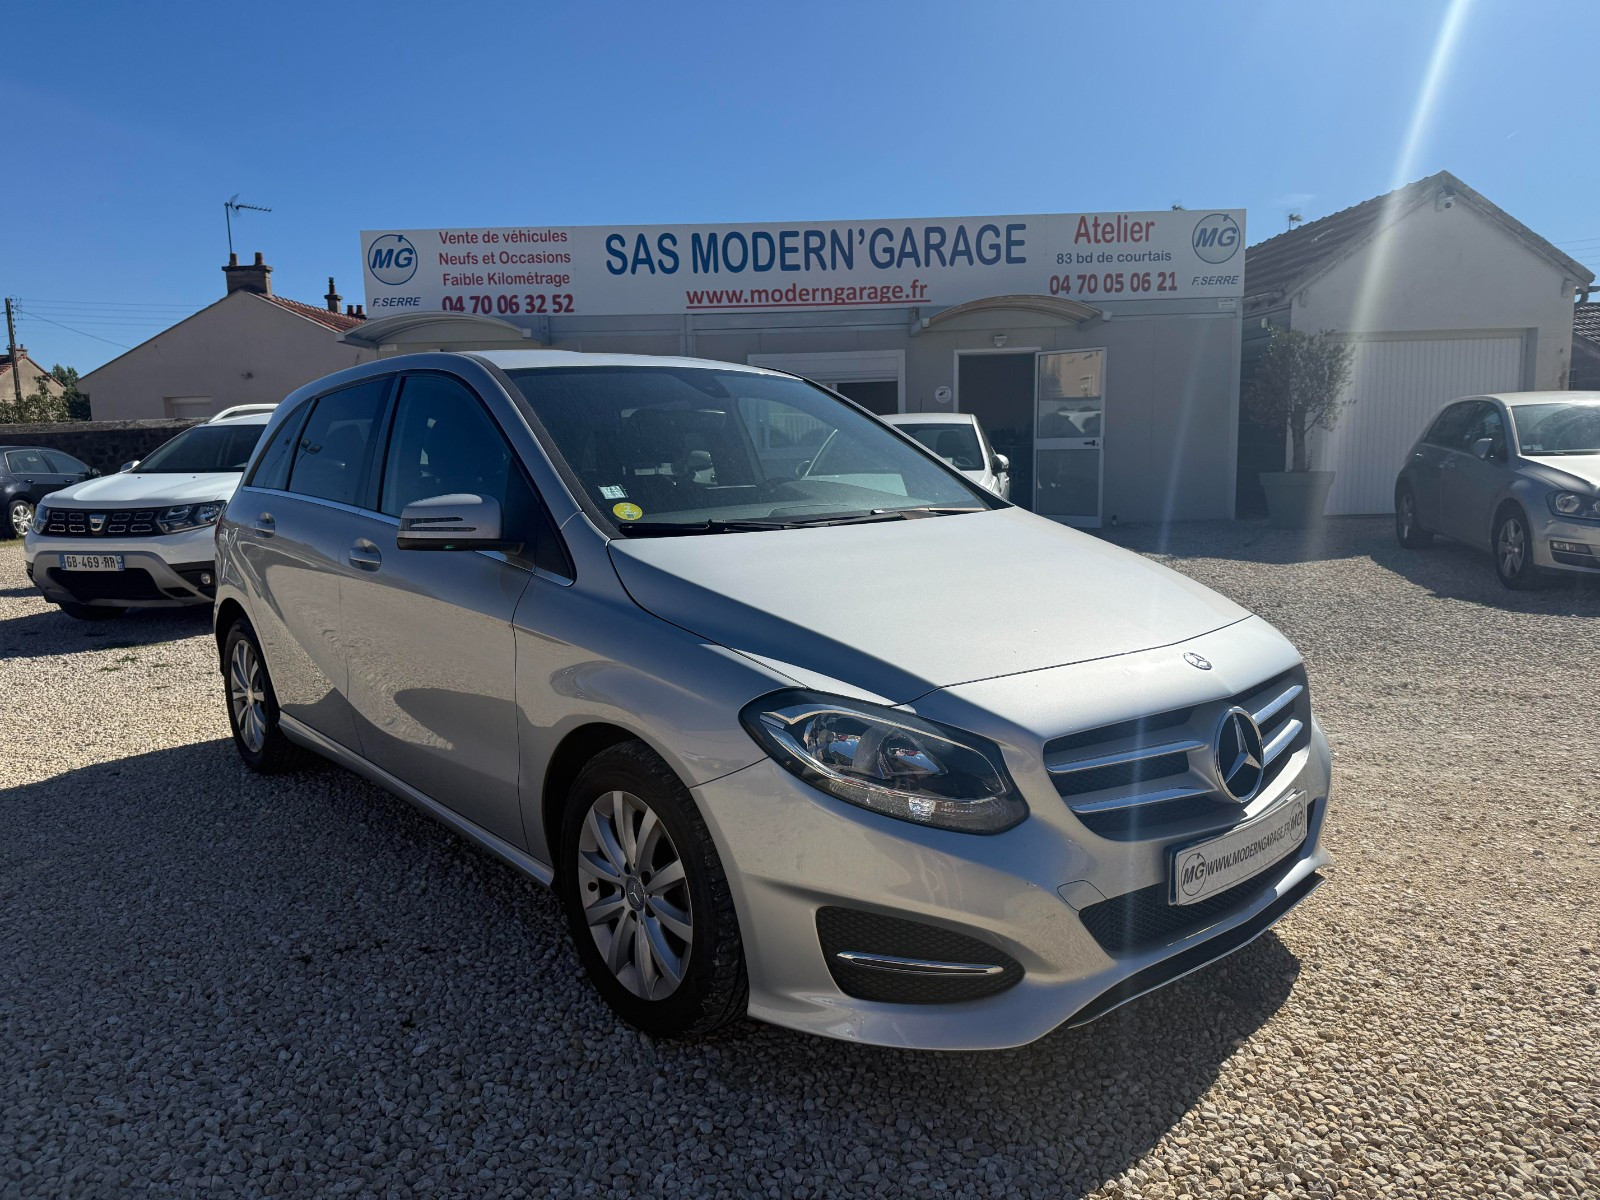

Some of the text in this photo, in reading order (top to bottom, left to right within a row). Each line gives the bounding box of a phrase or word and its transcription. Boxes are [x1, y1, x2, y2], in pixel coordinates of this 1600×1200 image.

[439, 229, 567, 244] Vente de véhicules
[1074, 214, 1155, 244] Atelier
[1195, 226, 1237, 247] MG
[371, 247, 413, 269] MG
[439, 251, 571, 265] Neufs et Occasions
[605, 223, 1027, 275] SAS MODERN'GARAGE
[1056, 250, 1172, 264] 83 bd de courtais
[443, 271, 570, 287] Faible Kilométrage
[1050, 271, 1178, 295] 04 70 05 06 21
[1192, 275, 1239, 286] F.SERRE
[372, 297, 421, 307] F.SERRE
[686, 279, 930, 307] www.moderngarage.fr
[442, 294, 575, 314] 04 70 06 32 52
[1182, 862, 1206, 886] MG
[1206, 821, 1291, 876] WWW.MODERNGARAGE.FR
